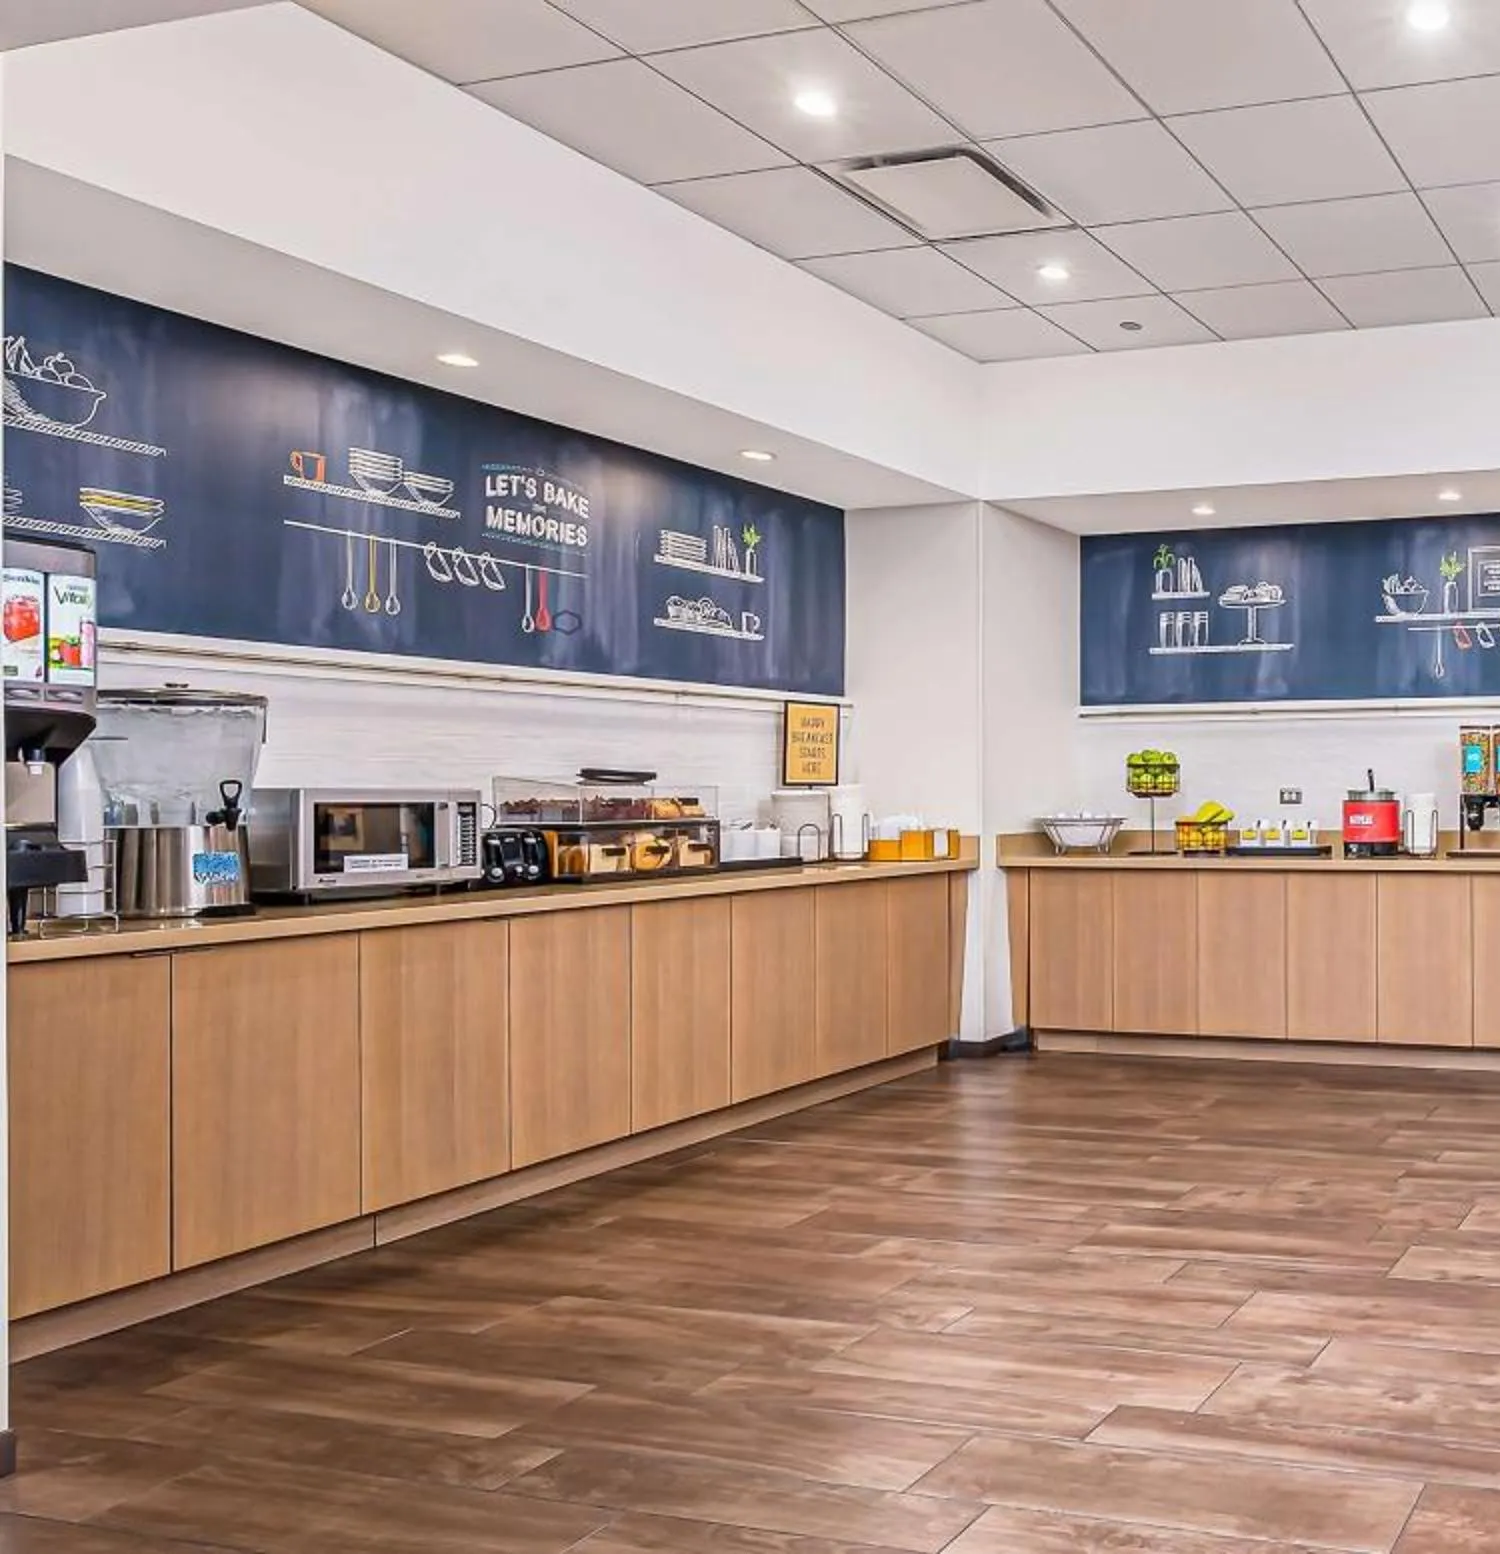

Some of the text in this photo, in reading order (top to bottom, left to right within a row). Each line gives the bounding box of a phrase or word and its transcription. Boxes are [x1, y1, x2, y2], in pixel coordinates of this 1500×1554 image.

[486, 474, 590, 519] LET'S BAKE
[486, 505, 588, 547] MEMORIES
